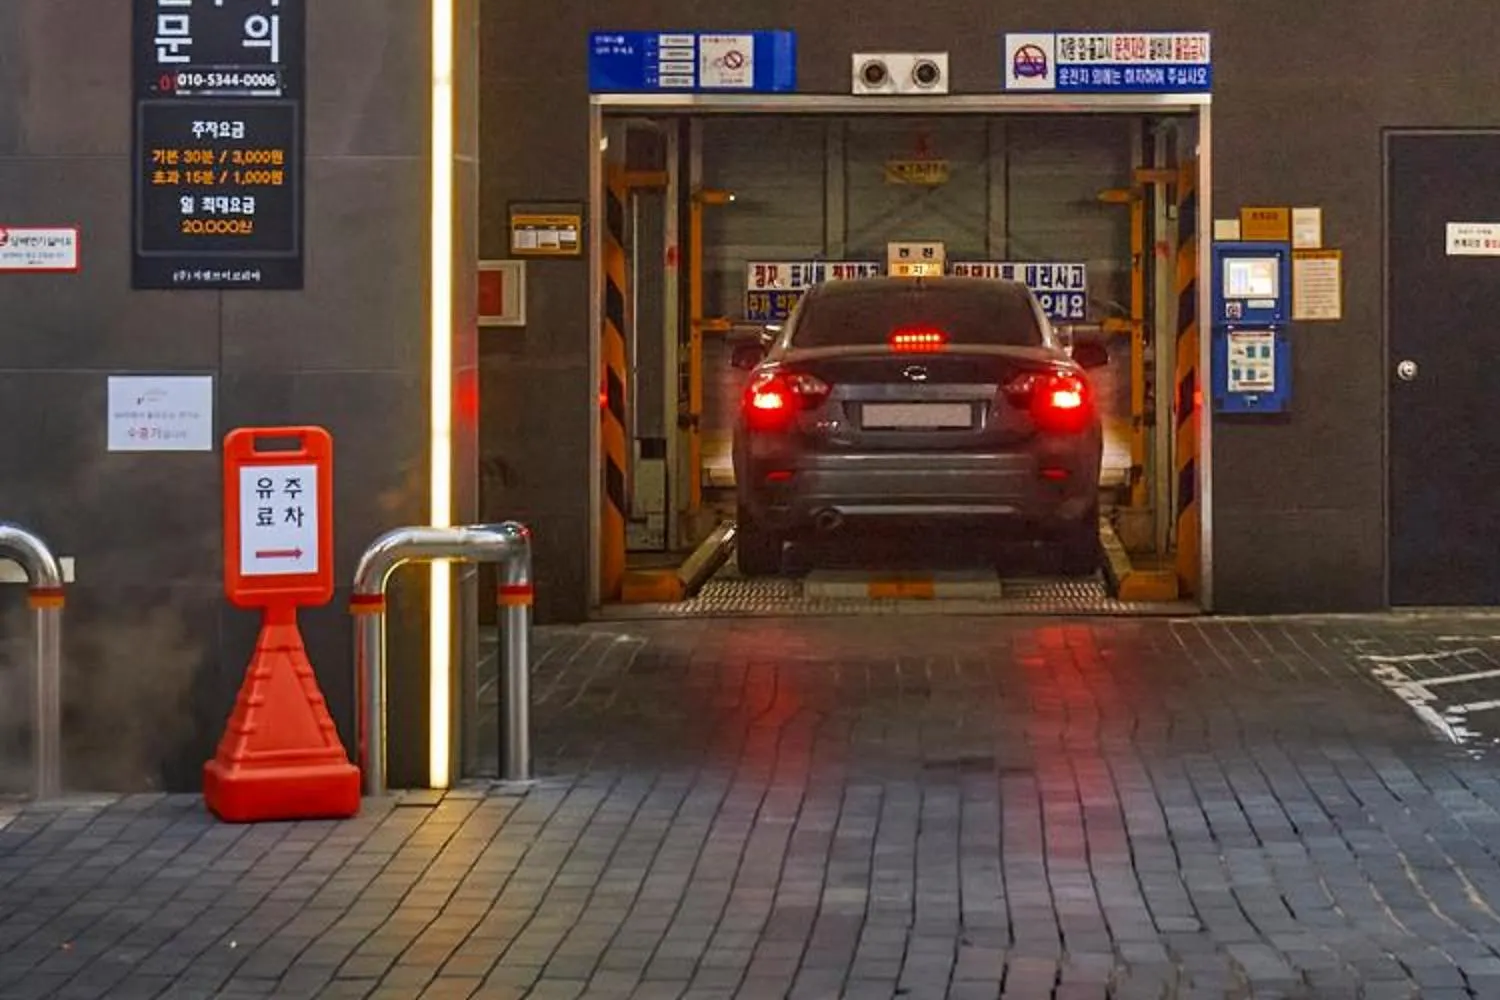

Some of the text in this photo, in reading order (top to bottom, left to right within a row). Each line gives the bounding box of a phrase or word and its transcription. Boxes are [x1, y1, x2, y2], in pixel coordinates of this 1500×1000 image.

[177, 73, 276, 87] 010-5344-0006
[1059, 68, 1089, 85] 운전자
[1167, 67, 1207, 85] 주십시오
